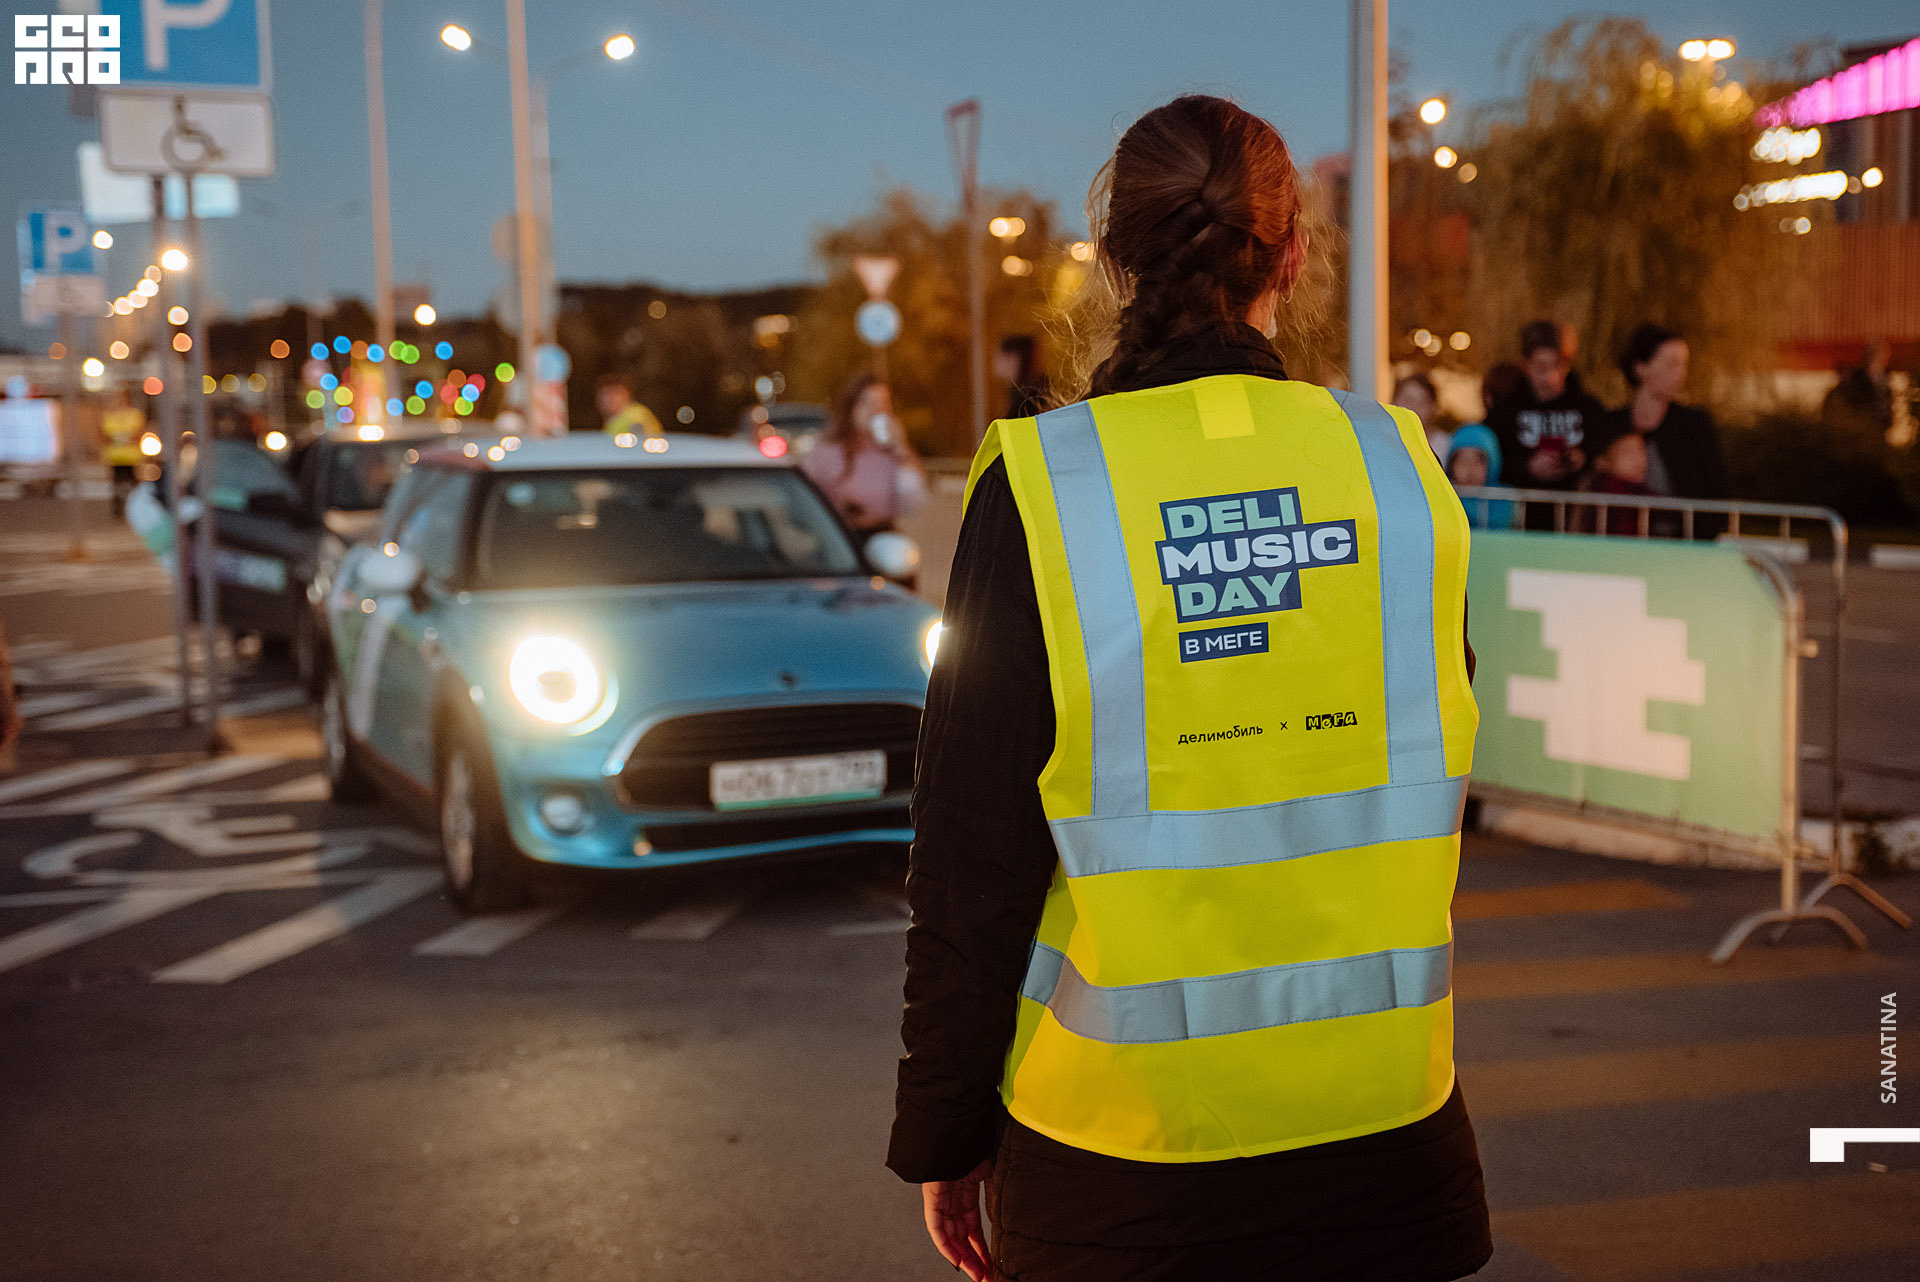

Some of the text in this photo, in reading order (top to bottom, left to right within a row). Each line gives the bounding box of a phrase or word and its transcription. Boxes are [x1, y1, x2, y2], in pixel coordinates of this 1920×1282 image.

[45, 211, 88, 272] P
[1166, 493, 1297, 539] DELI
[1161, 526, 1352, 579] MUSIC
[1177, 571, 1293, 617] DAY
[1185, 630, 1263, 655] В МЕГЕ
[1178, 724, 1264, 745] делимобиль
